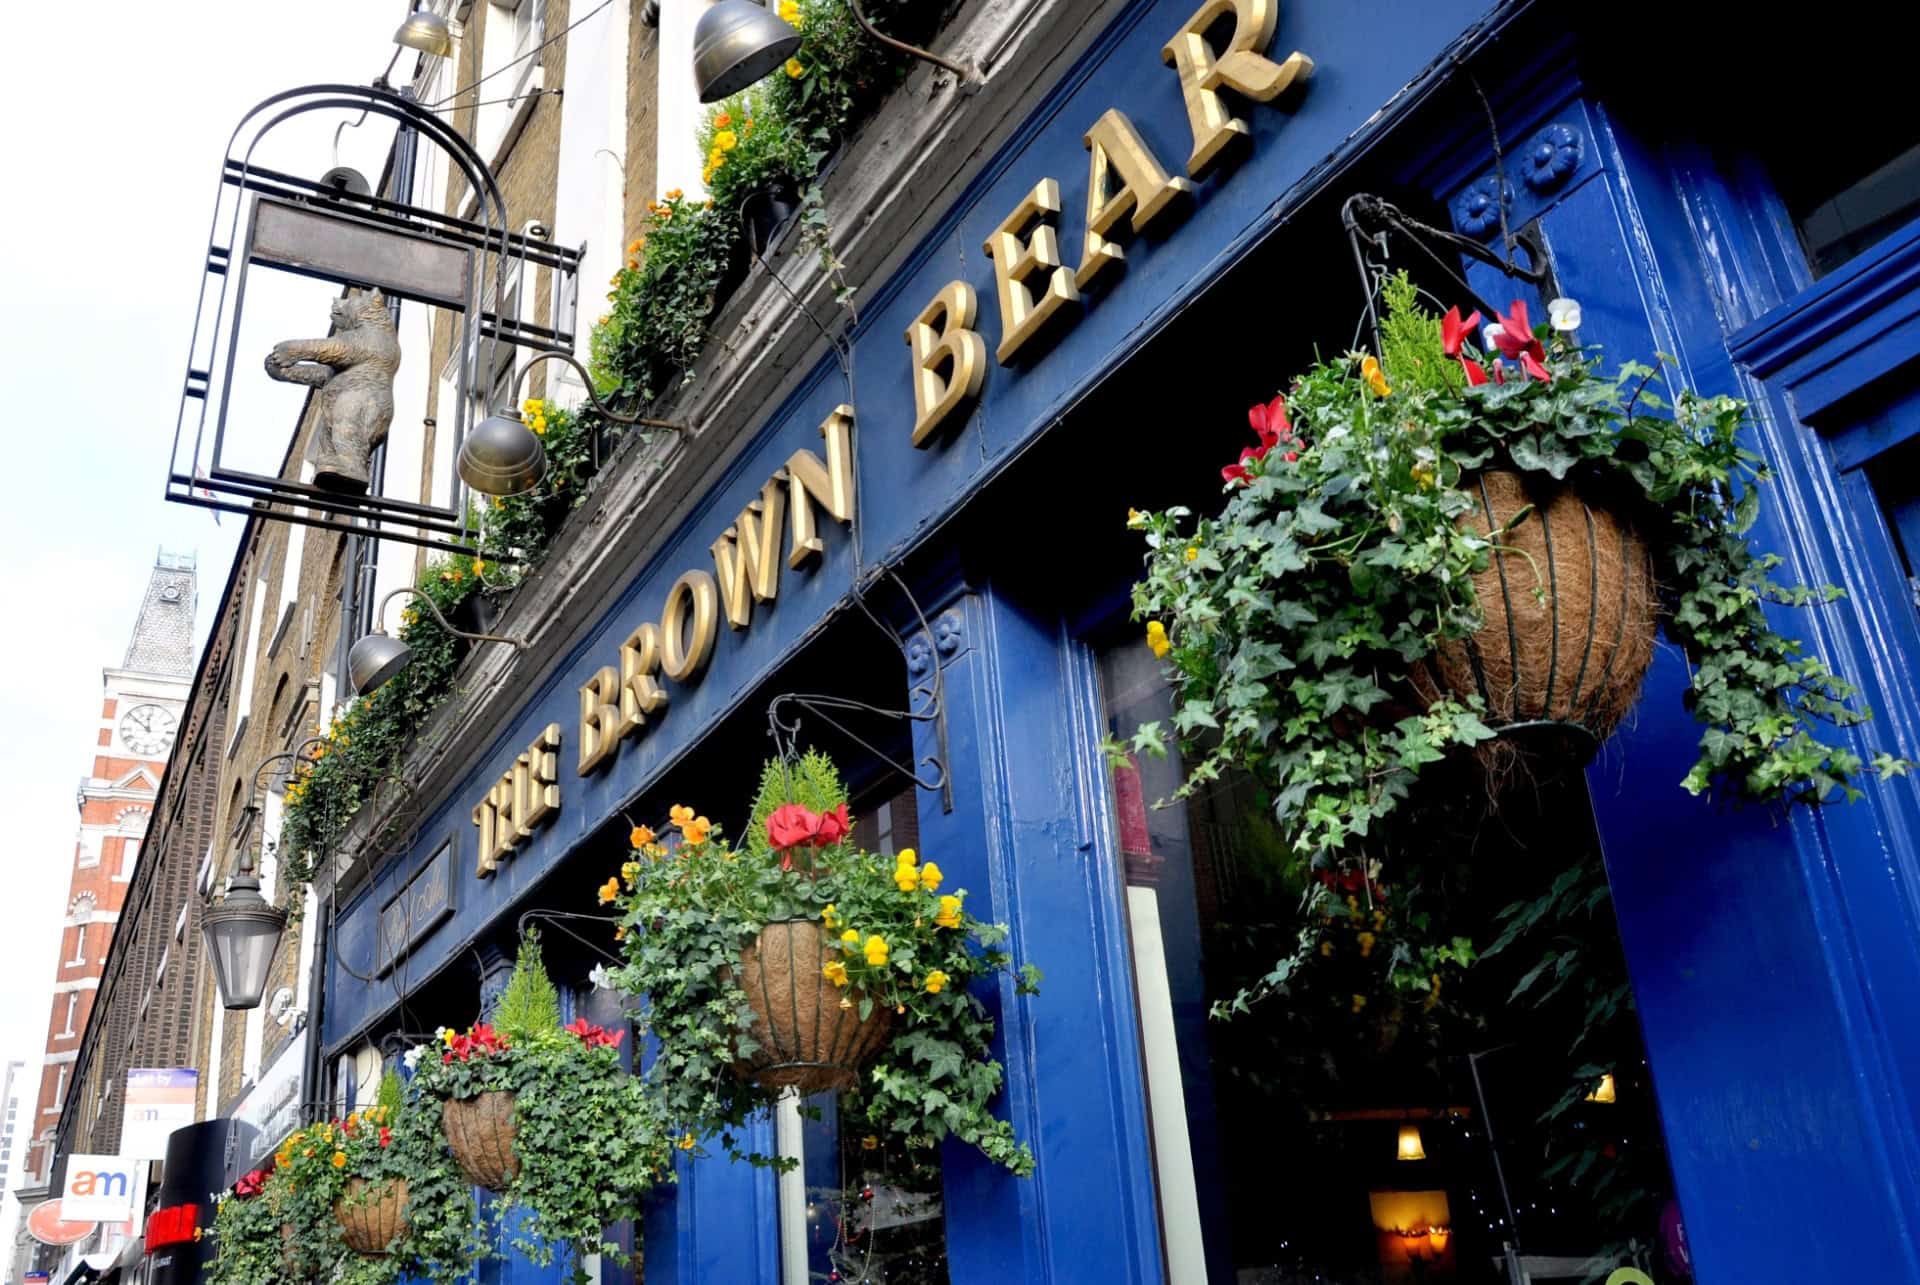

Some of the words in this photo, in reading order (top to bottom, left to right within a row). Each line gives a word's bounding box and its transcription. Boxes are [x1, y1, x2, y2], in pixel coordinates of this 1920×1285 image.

[472, 723, 560, 879] THE
[578, 403, 855, 777] BROWN
[904, 0, 1314, 449] BEAR
[71, 1170, 127, 1196] am
